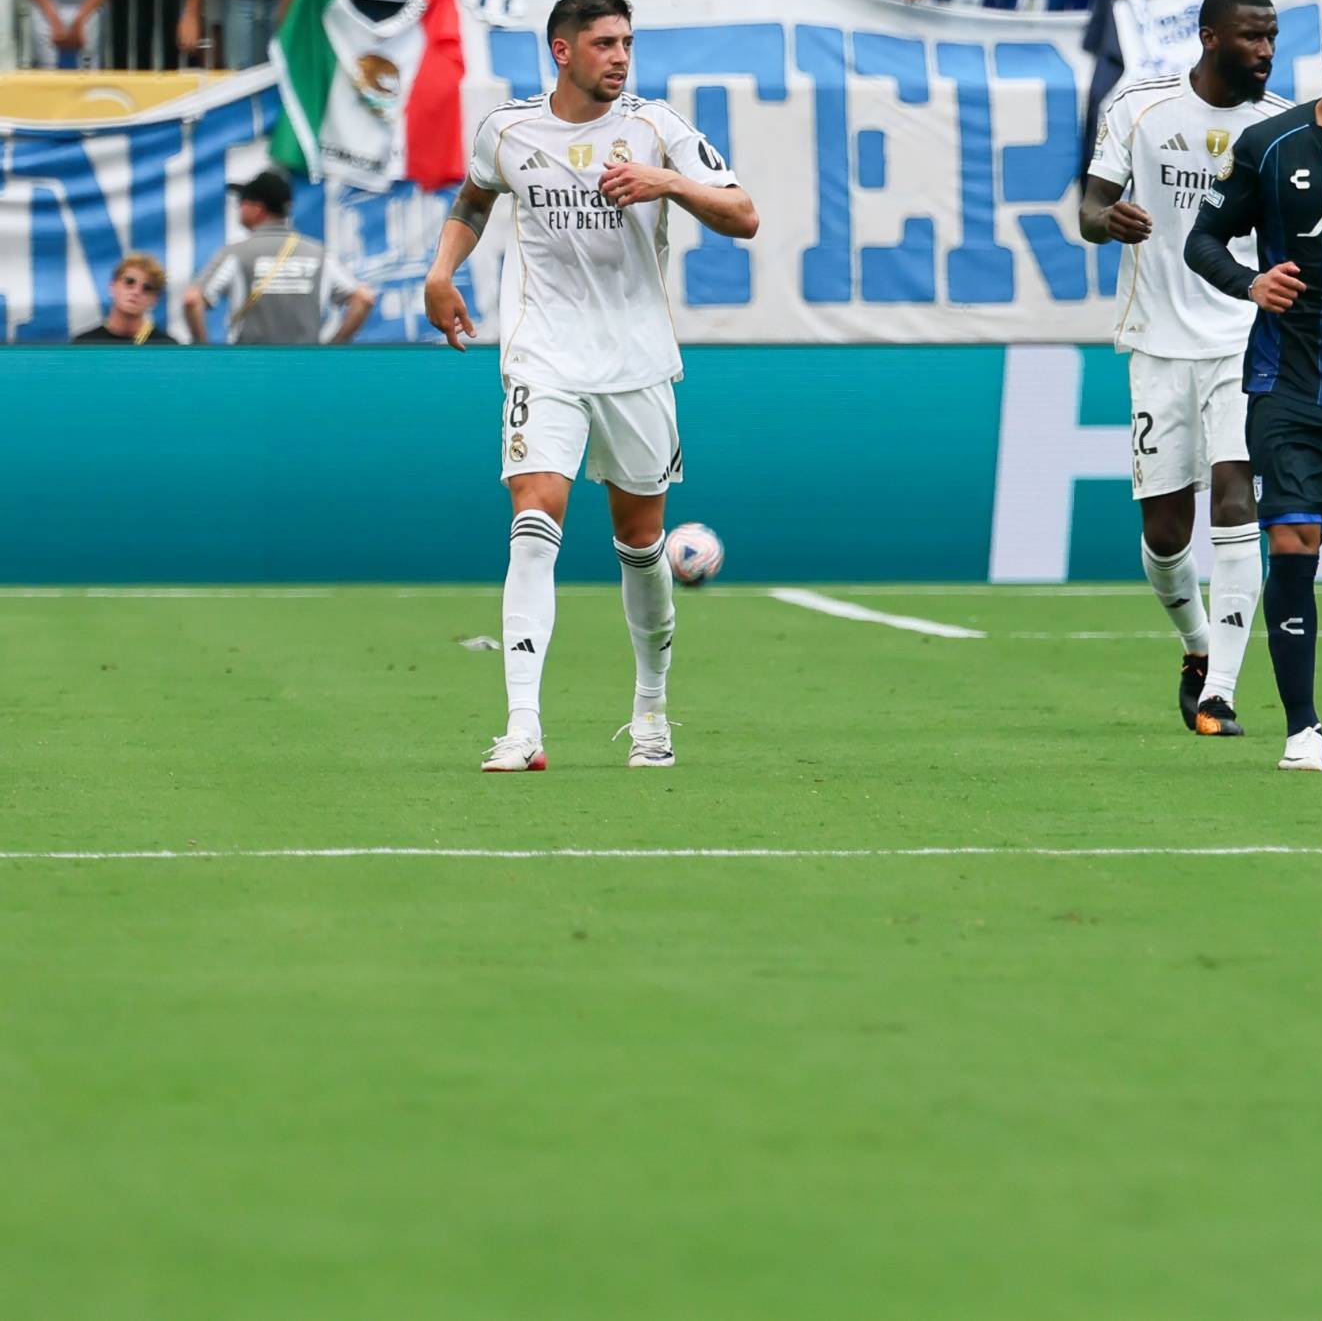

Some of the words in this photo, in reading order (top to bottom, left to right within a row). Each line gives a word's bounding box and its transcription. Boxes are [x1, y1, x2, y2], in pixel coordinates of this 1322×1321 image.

[1160, 163, 1217, 190] Emir
[528, 183, 618, 209] Emira
[1173, 191, 1196, 210] FLY
[549, 210, 573, 230] FLY
[577, 209, 624, 230] BETTER
[509, 384, 530, 429] 8
[1131, 411, 1159, 456] 2
